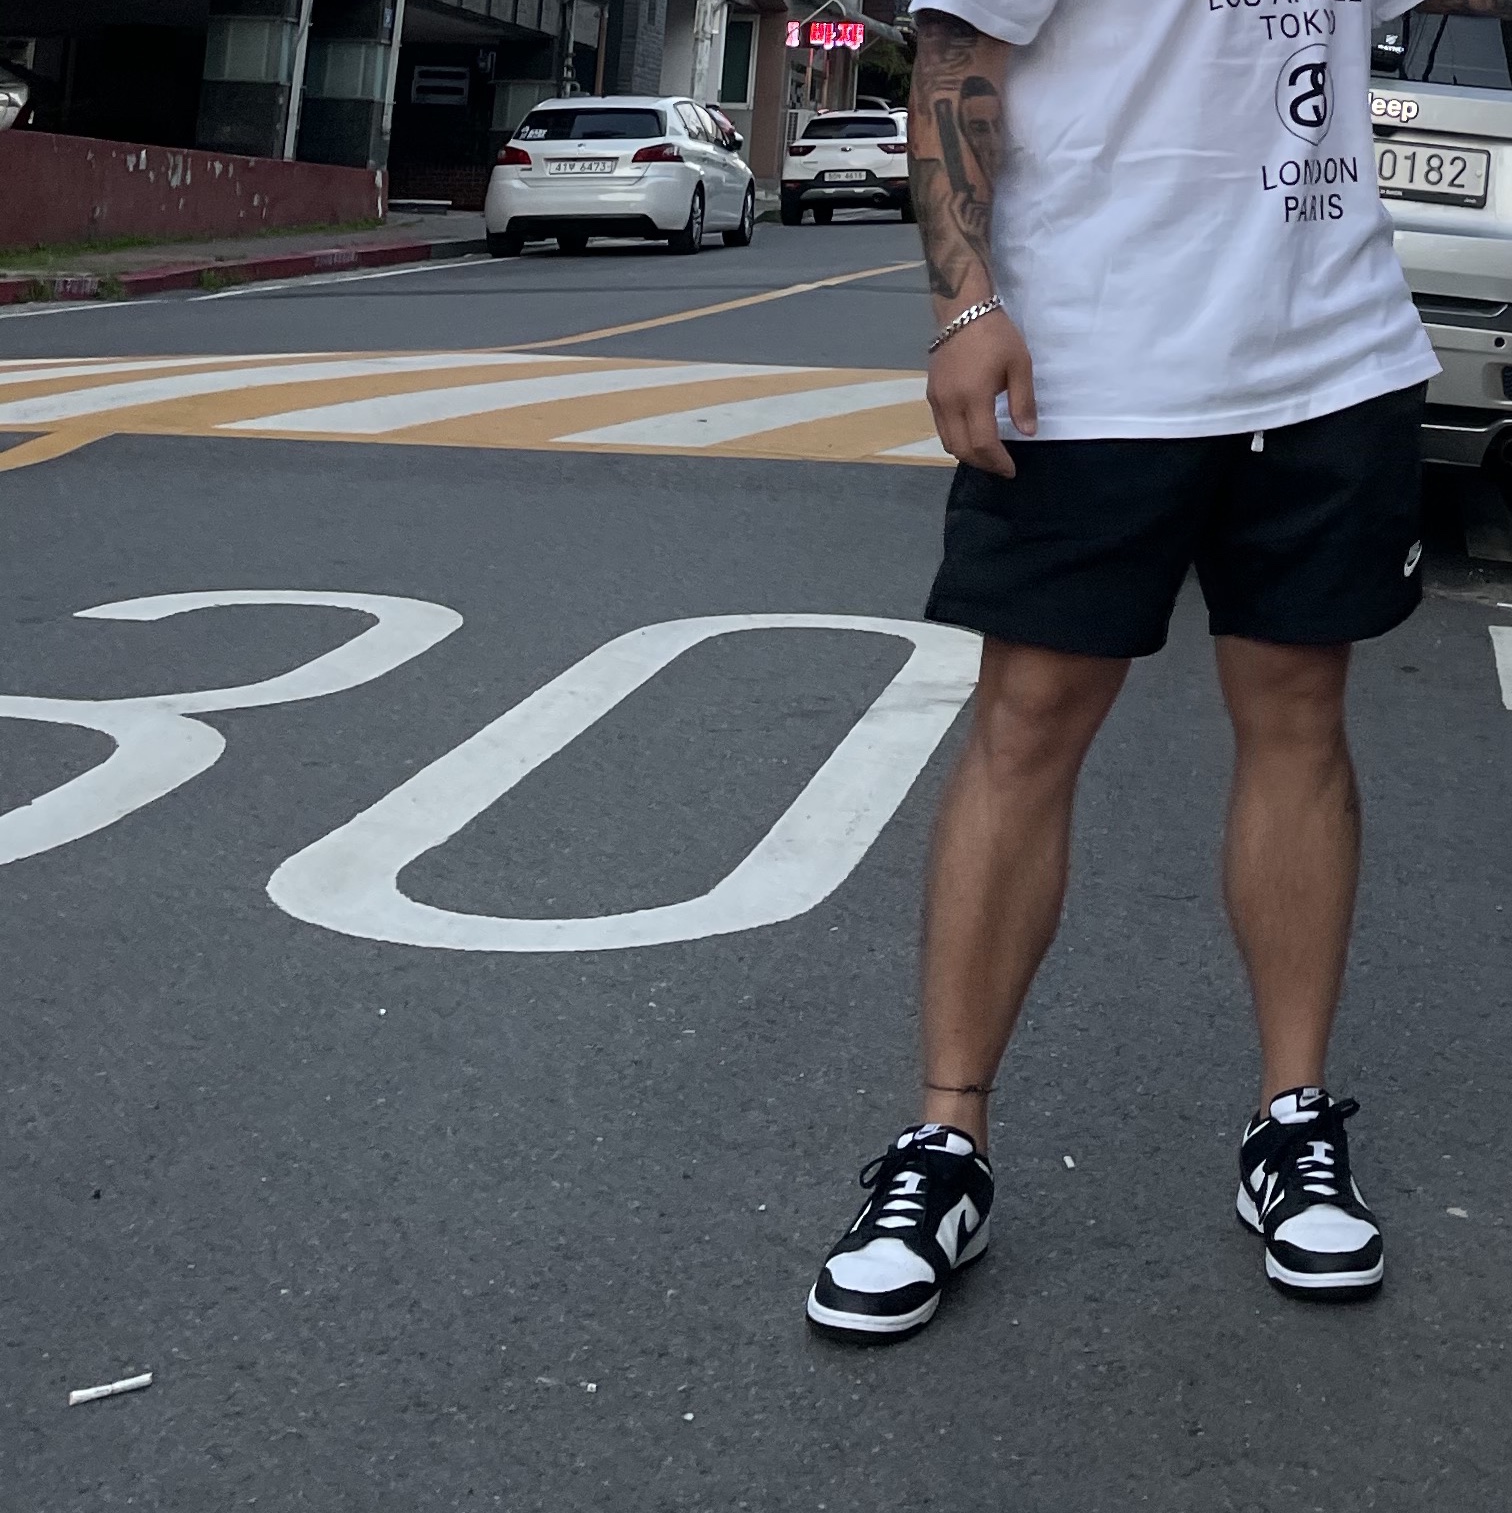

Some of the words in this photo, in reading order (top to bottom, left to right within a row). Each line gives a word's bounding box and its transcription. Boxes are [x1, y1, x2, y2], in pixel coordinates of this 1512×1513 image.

[1262, 156, 1359, 190] LONDON
[1378, 148, 1467, 188] 0182
[1284, 193, 1344, 223] PARIS
[0, 589, 983, 952] 30
